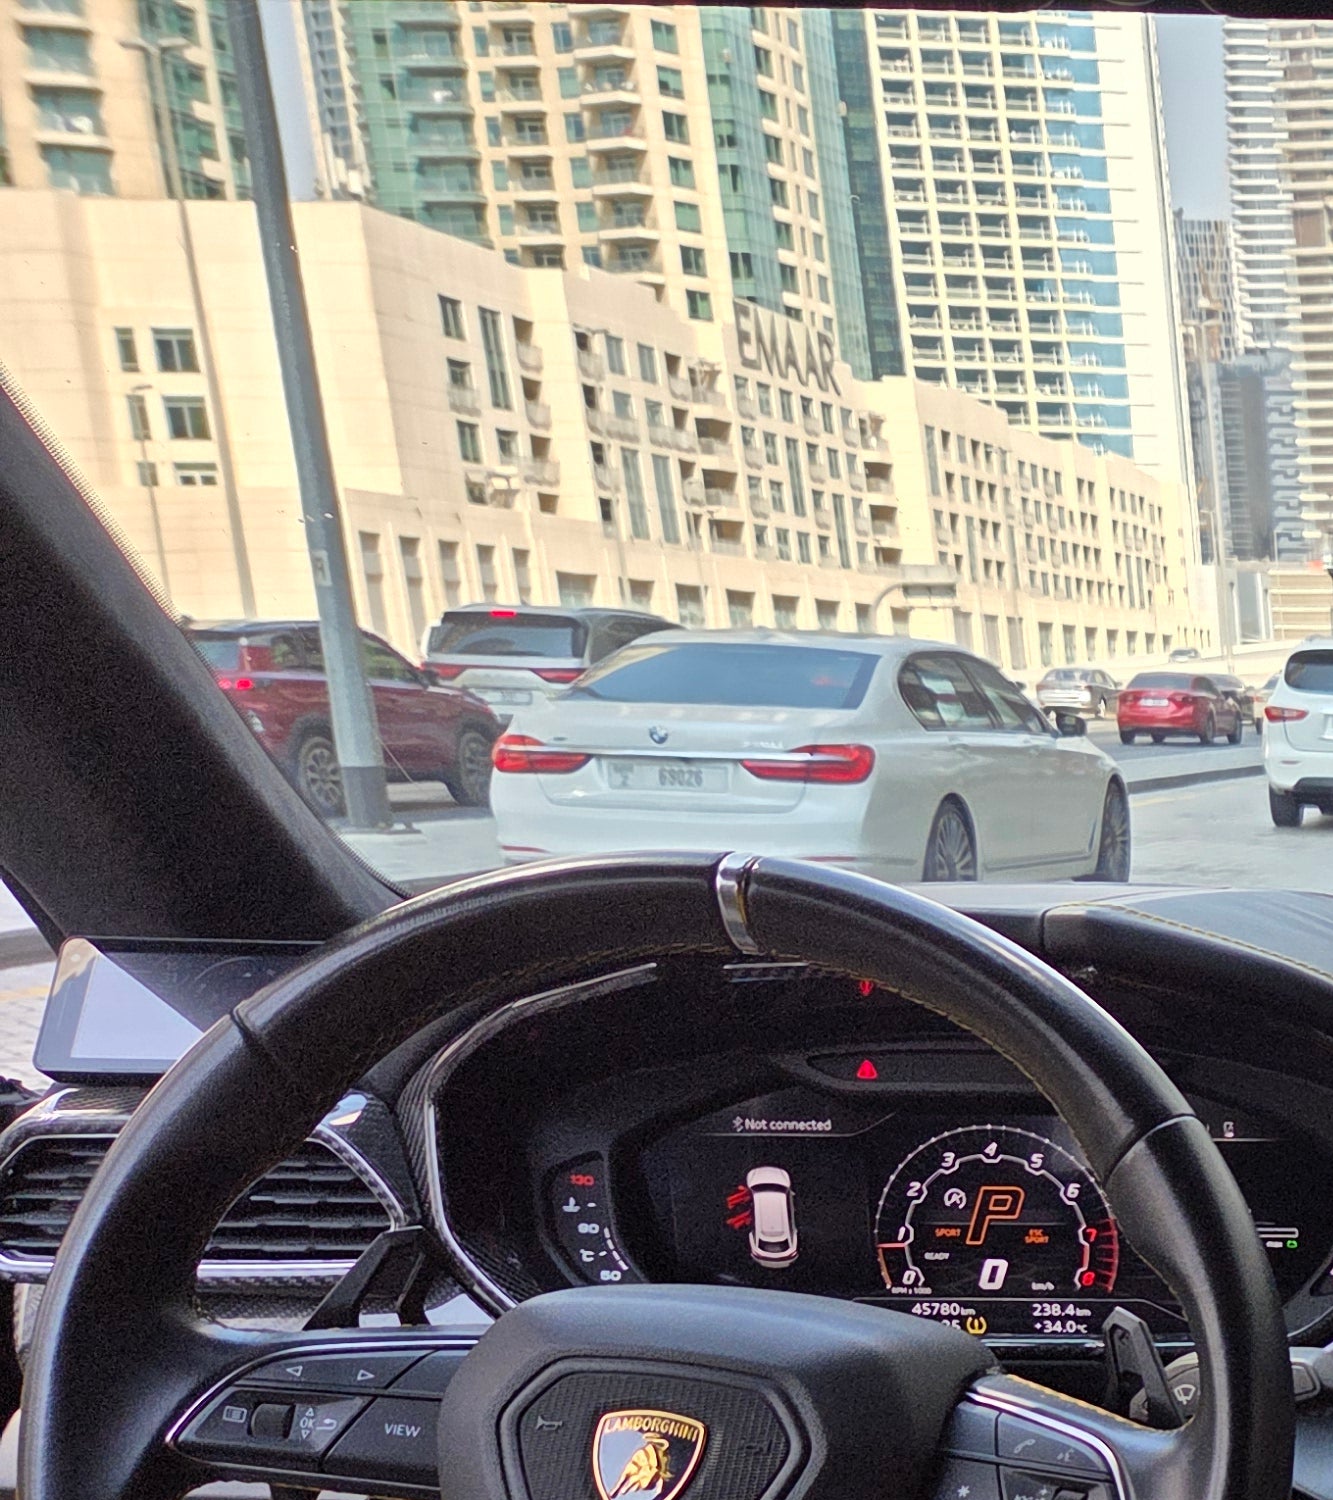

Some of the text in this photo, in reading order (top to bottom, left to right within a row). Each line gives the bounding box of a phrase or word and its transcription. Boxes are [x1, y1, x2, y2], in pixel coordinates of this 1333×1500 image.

[733, 301, 841, 397] EMAAR
[744, 1118, 832, 1131] Not connected
[984, 1142, 998, 1157] 4
[941, 1152, 956, 1168] 3
[1030, 1153, 1045, 1168] 5
[907, 1182, 922, 1197] 2
[1066, 1183, 1081, 1199] 6
[965, 1186, 1025, 1245] P
[897, 1226, 906, 1241] 1
[935, 1228, 962, 1238] SPORT
[1024, 1235, 1050, 1244] SPORT
[1086, 1228, 1098, 1243] 7
[902, 1270, 916, 1286] 0
[978, 1258, 1009, 1291] 0
[1031, 1281, 1055, 1291] km/h
[300, 1417, 316, 1430] OK
[384, 1422, 421, 1438] VIEW
[604, 1416, 698, 1443] LAMBORGHINI
